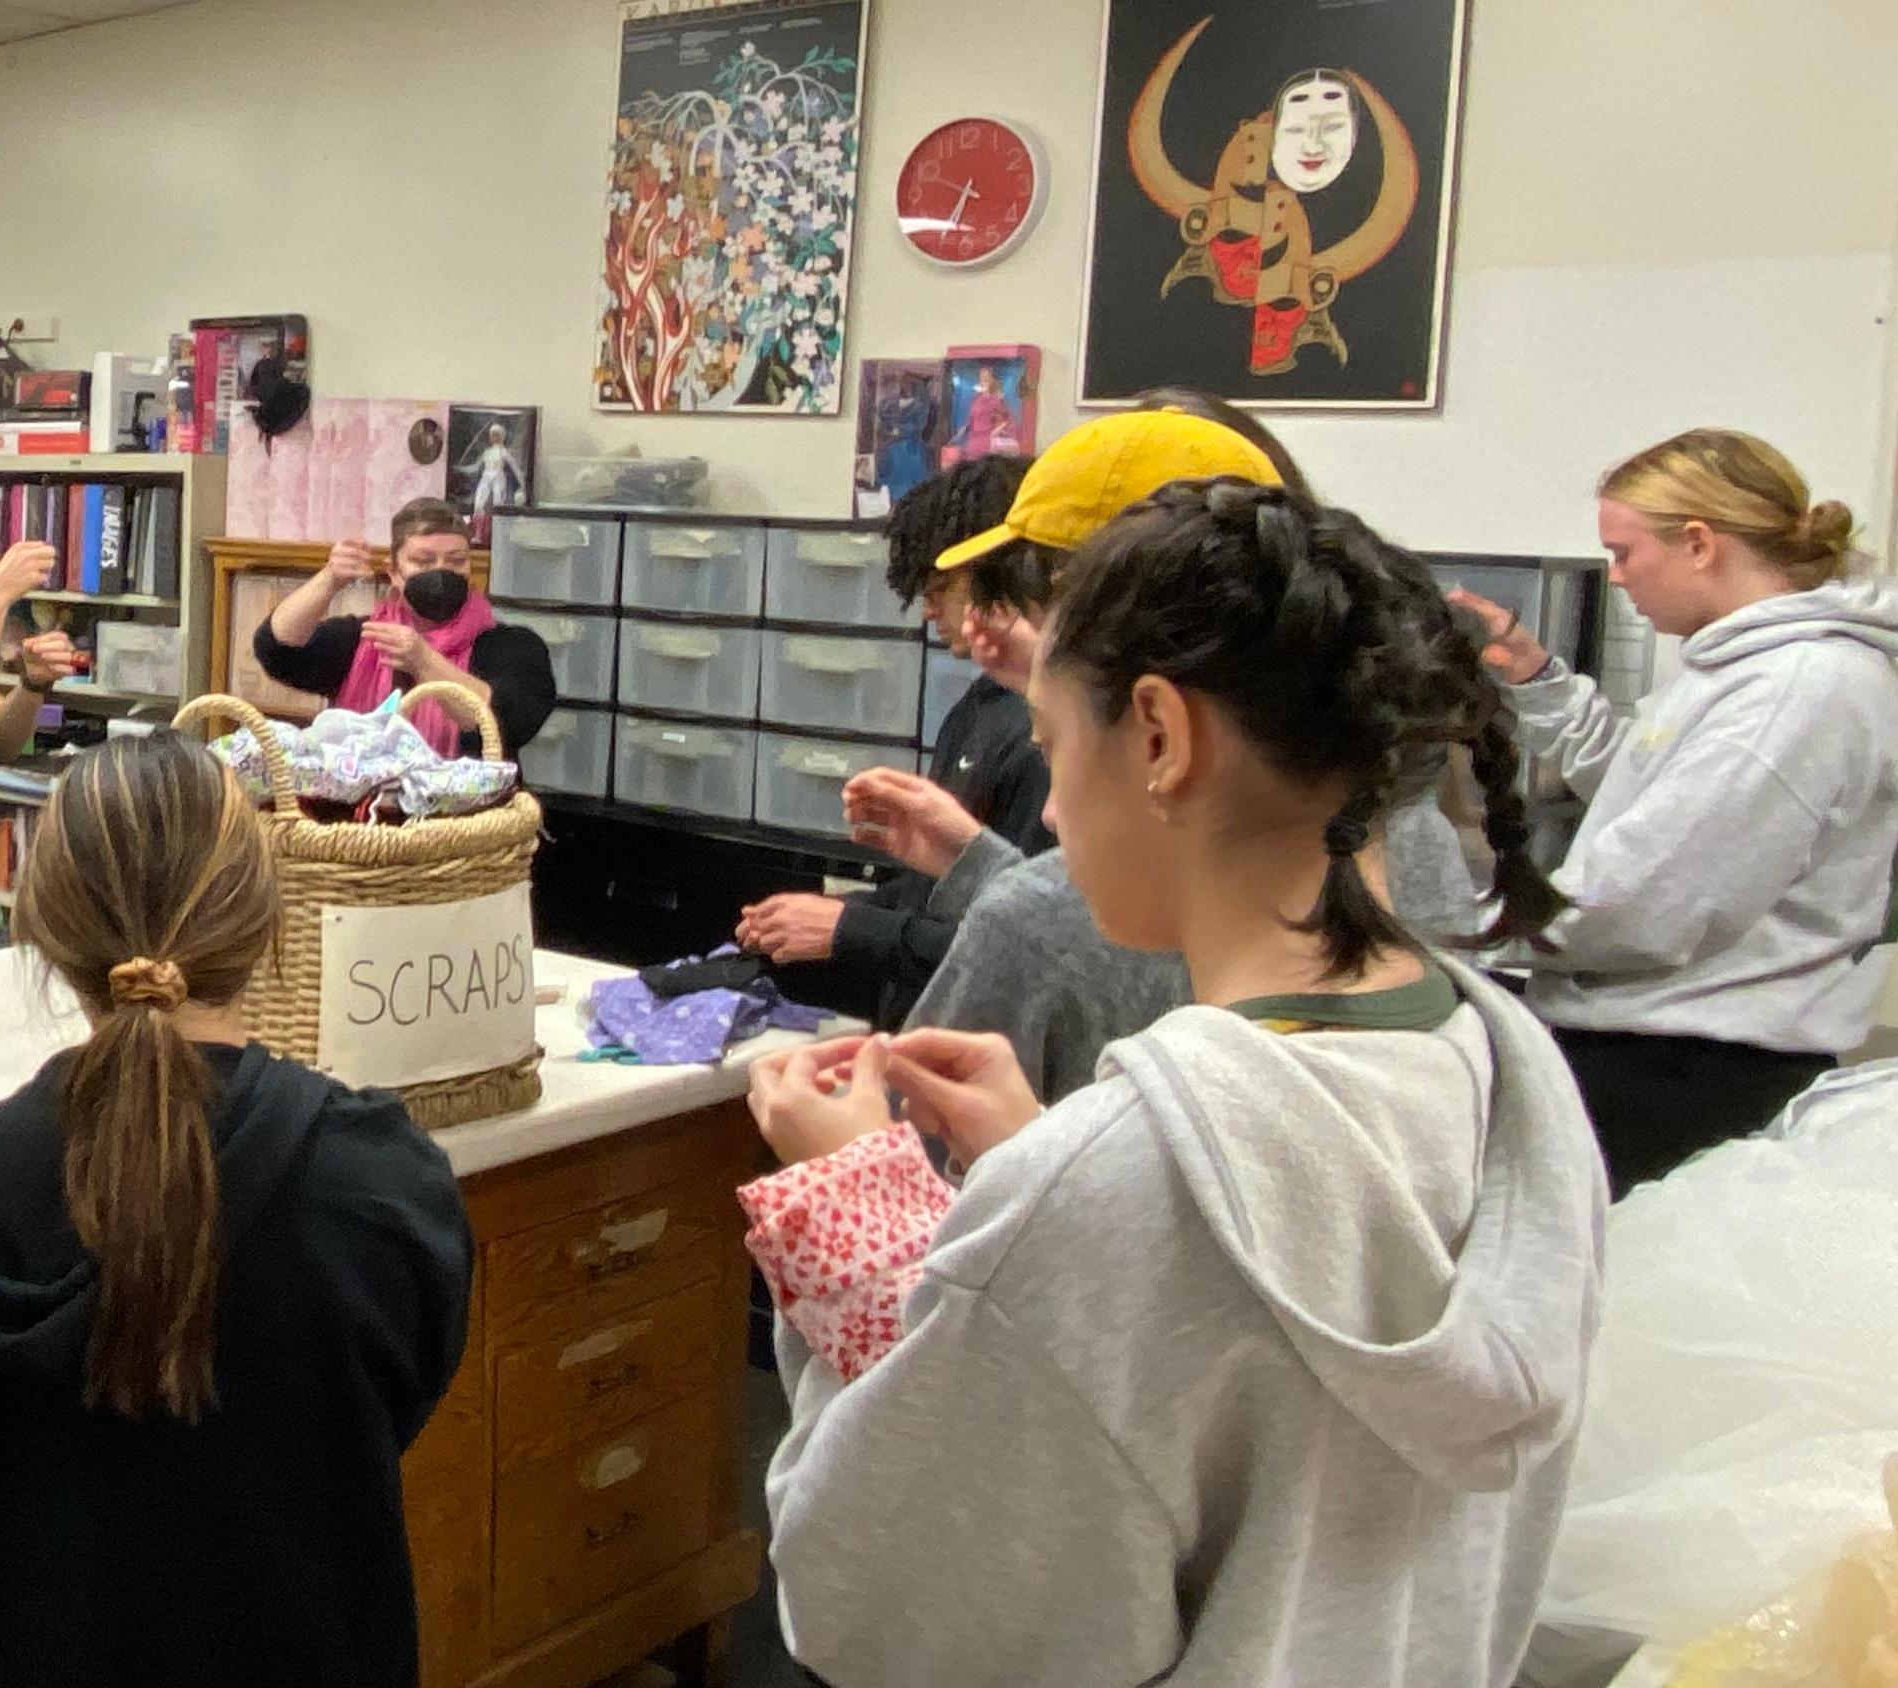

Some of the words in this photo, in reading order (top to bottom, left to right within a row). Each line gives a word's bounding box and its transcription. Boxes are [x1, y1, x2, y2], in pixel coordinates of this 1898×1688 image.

[938, 137, 953, 159] 11
[959, 126, 981, 149] 12
[993, 129, 1000, 151] 1
[1005, 147, 1023, 171] 2
[917, 159, 940, 182] 10
[1004, 201, 1019, 223] 4
[959, 234, 975, 256] 6
[985, 224, 1001, 246] 5
[347, 933, 526, 1026] SCRAPS
